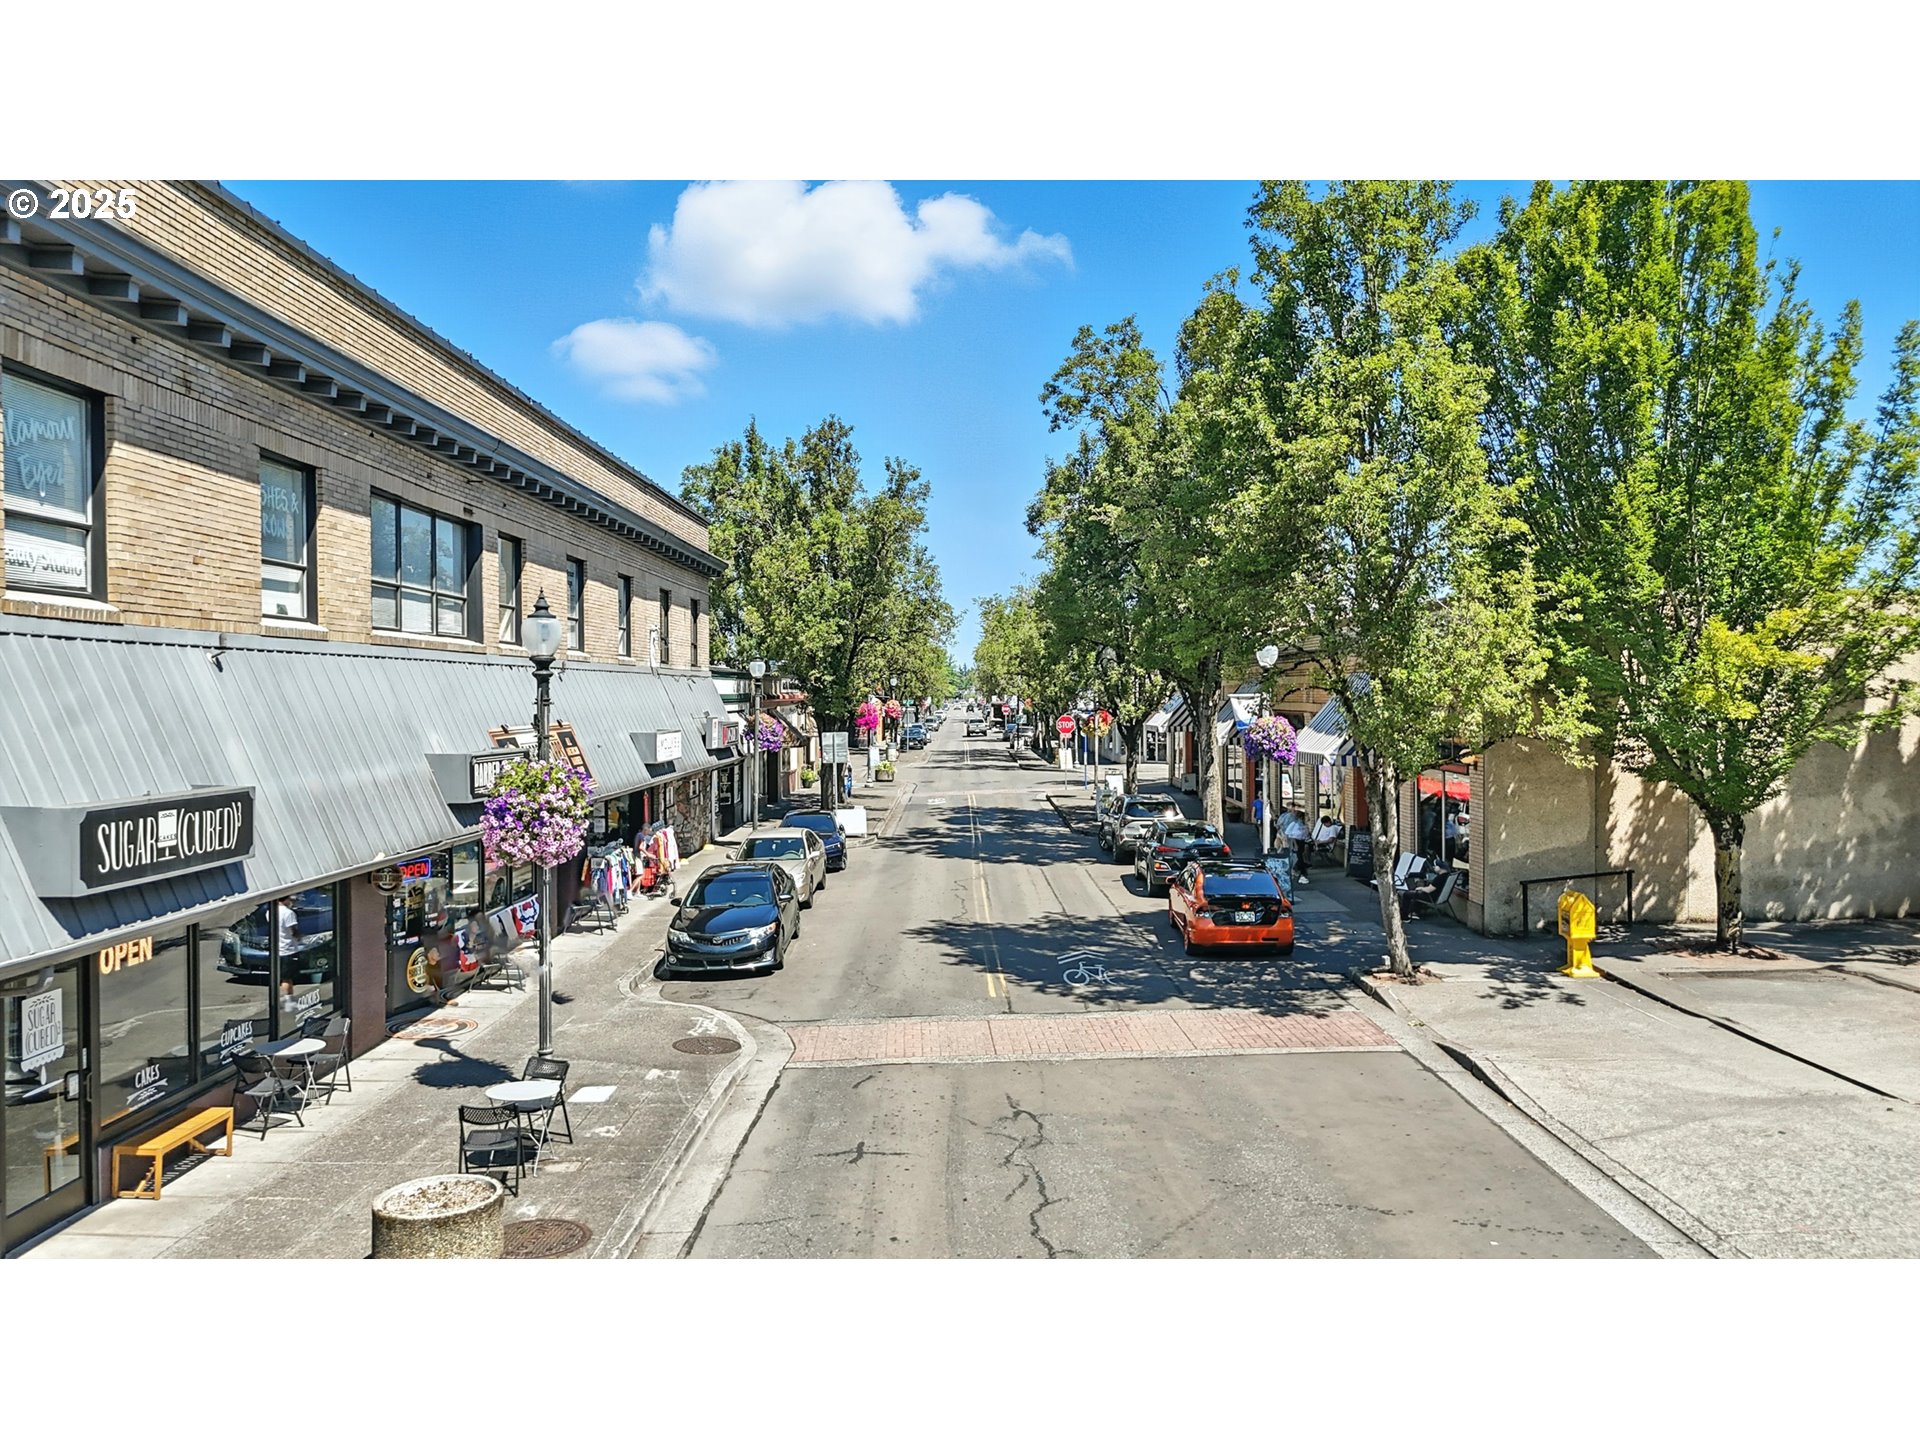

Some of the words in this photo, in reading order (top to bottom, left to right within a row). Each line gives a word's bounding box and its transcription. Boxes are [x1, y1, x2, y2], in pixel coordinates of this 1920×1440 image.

[4, 408, 75, 447] lamour
[1058, 721, 1074, 729] STOP
[97, 816, 157, 874] SUGAR
[401, 862, 429, 878] OPEN
[100, 936, 153, 975] OPEN
[297, 988, 320, 1011] COOKIES
[27, 1002, 56, 1031] SUGAR
[220, 1020, 253, 1048] CUPCAKES
[134, 1063, 160, 1089] CAKES
